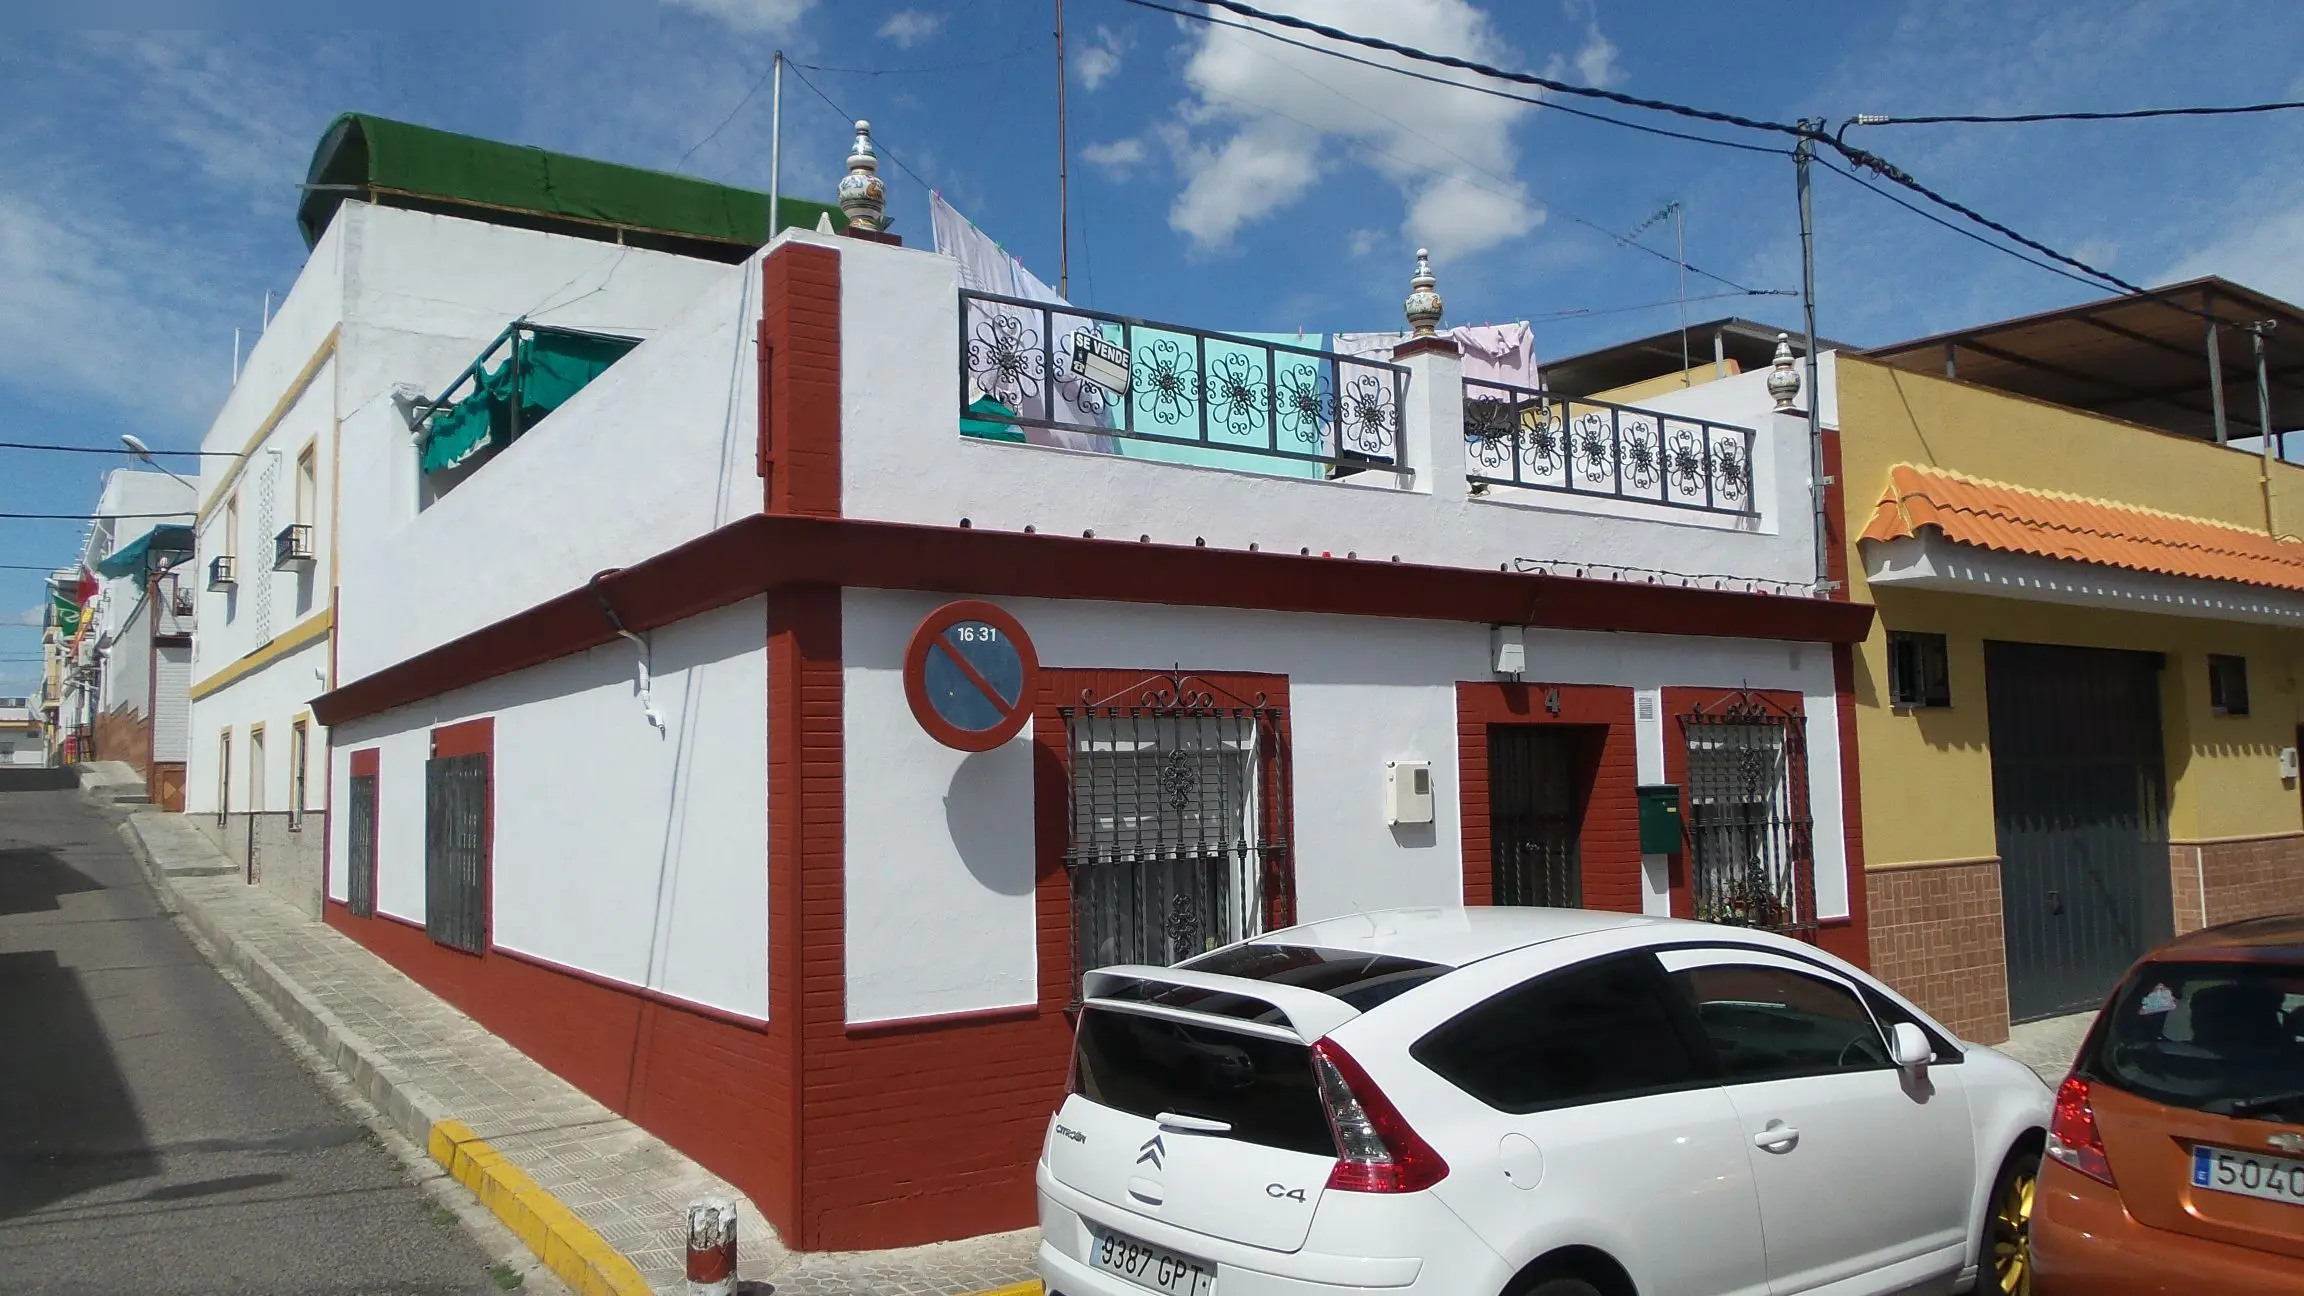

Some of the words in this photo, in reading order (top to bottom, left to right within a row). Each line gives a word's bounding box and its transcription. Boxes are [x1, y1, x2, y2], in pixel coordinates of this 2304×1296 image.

[1076, 333, 1091, 351] SE
[1093, 340, 1129, 369] VENDE
[1544, 687, 1560, 713] 4
[1265, 1183, 1306, 1204] C4
[2217, 1154, 2304, 1197] 5040
[1101, 1235, 1154, 1277] 9387
[1157, 1255, 1204, 1296] GPT
